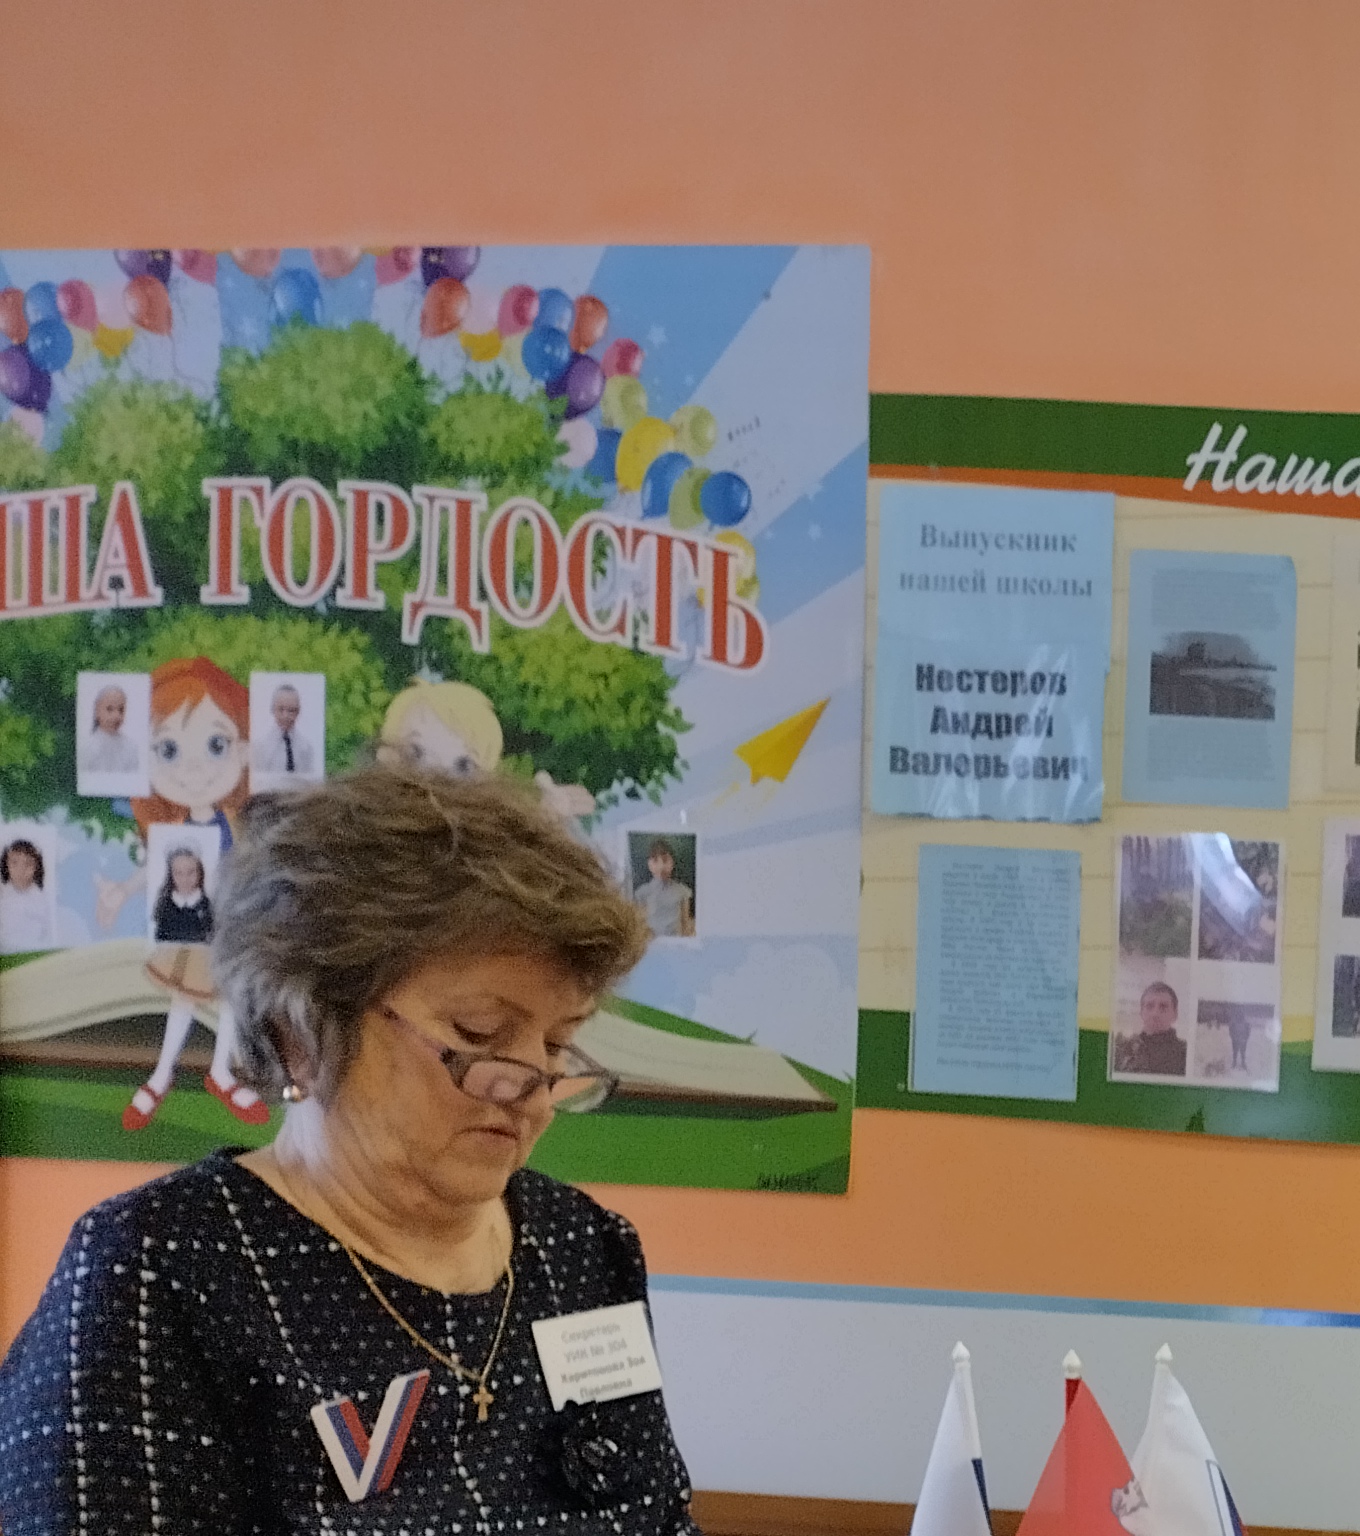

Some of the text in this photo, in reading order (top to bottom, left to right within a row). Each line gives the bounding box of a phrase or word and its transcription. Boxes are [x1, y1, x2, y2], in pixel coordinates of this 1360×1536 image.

[920, 523, 1077, 556] Выпускник
[202, 477, 771, 677] ГОРДОСТЬ
[899, 569, 1093, 598] нашей школы
[915, 663, 1068, 698] Нестеров
[930, 705, 1054, 739] Андрей
